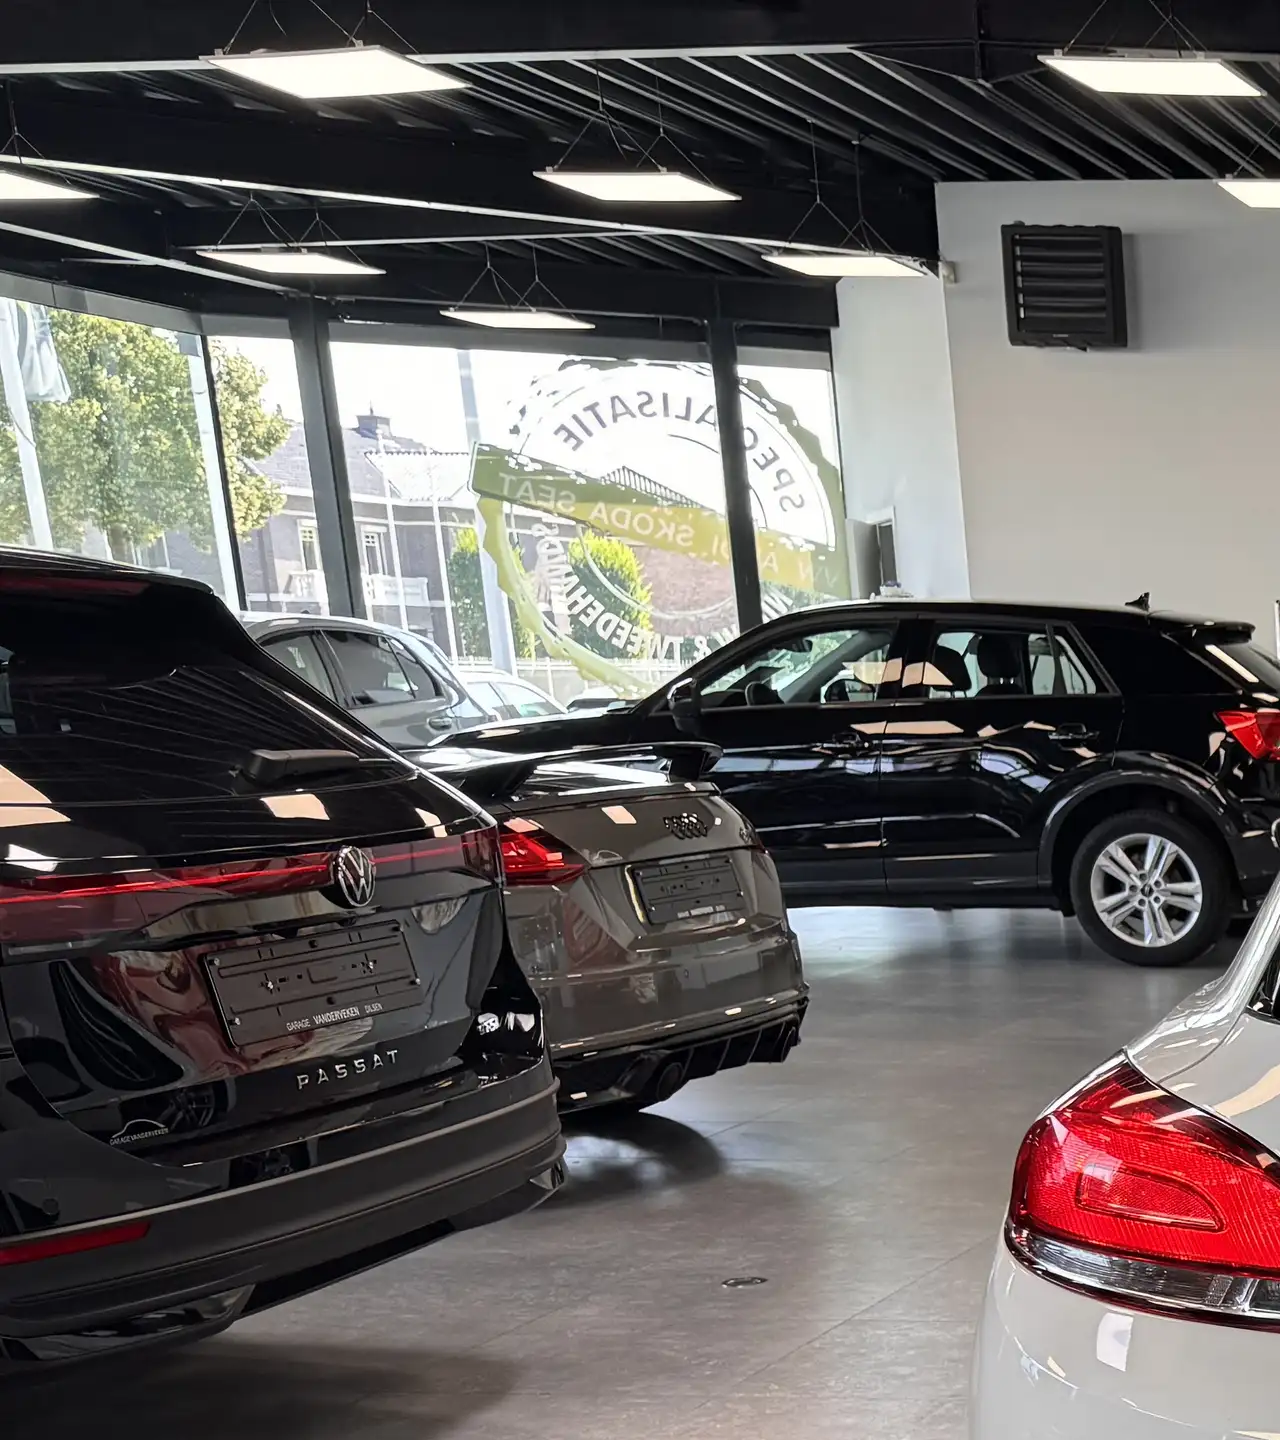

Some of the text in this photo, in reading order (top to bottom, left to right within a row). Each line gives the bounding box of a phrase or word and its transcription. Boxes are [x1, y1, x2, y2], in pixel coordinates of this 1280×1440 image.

[286, 1002, 383, 1032] GARAGE VANDERVEKEN DILSEN
[296, 1049, 399, 1090] PASSAT
